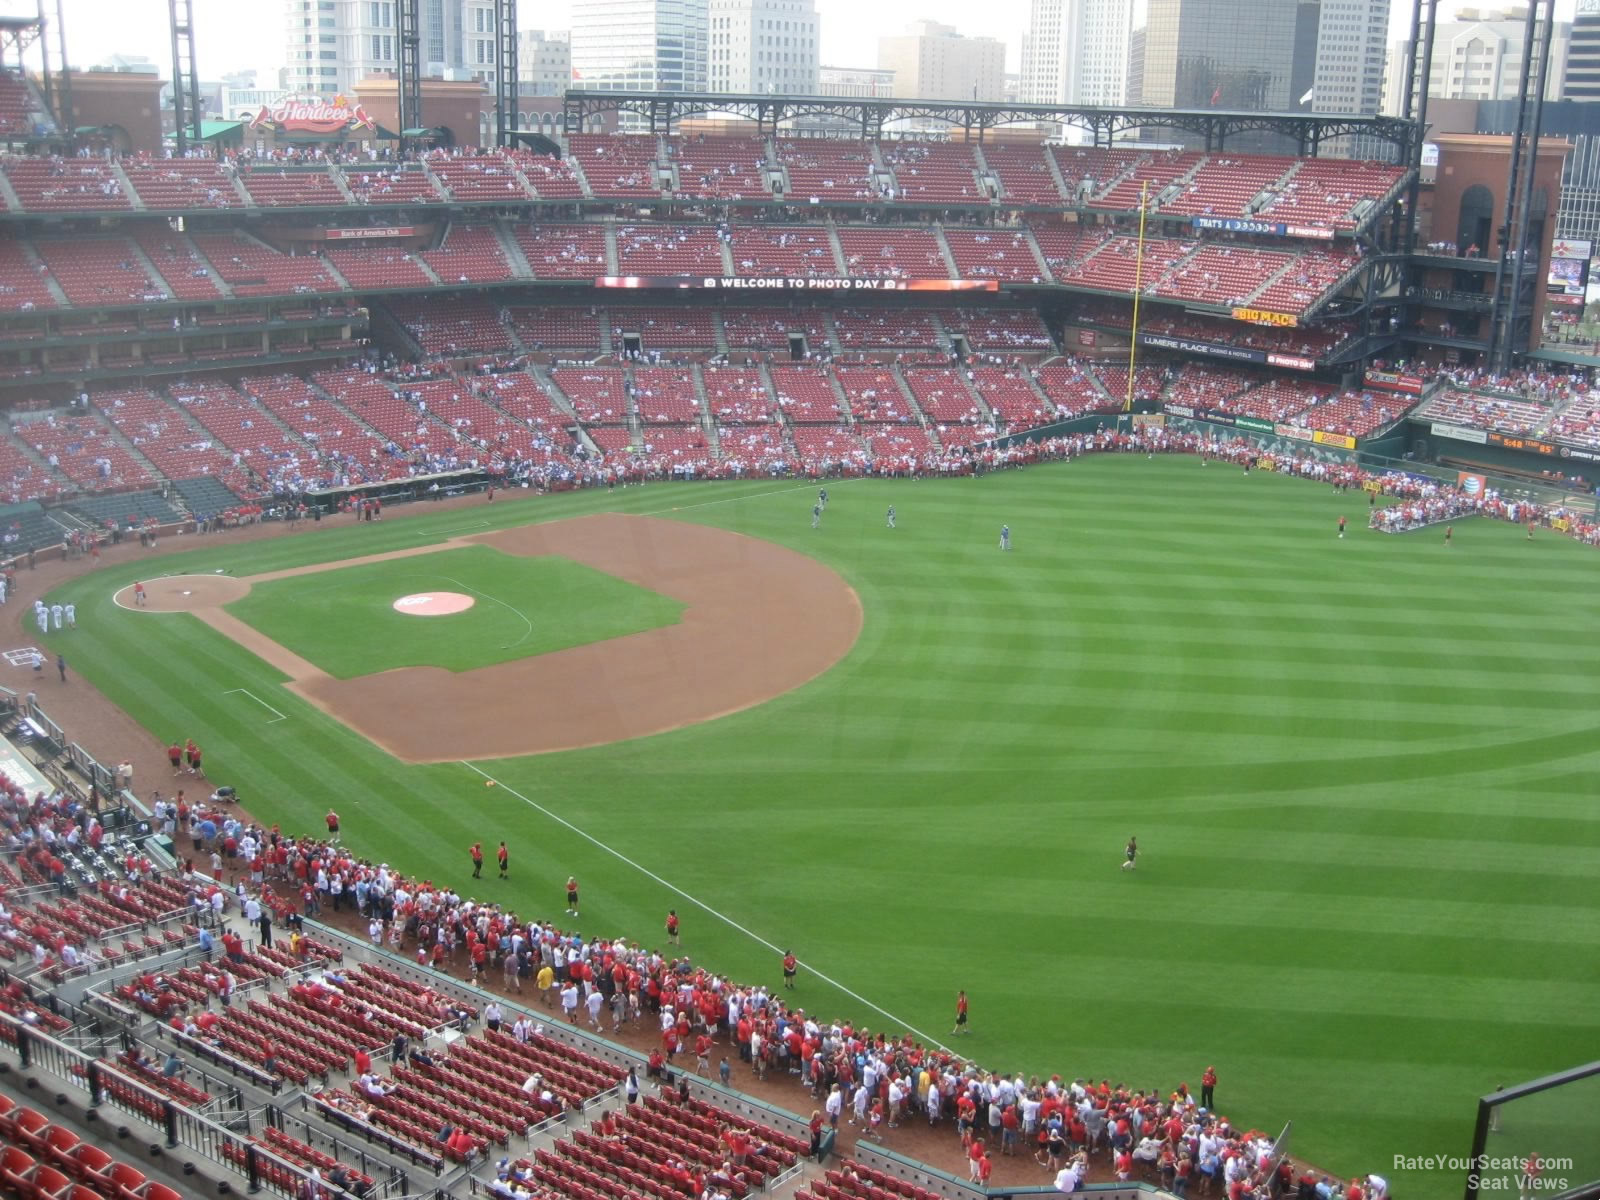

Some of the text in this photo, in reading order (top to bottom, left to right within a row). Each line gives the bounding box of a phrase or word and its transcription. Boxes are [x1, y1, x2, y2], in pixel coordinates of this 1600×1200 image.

[1225, 221, 1231, 230] A
[341, 230, 355, 238] Bank
[1295, 226, 1333, 239] PHOTO DAY
[721, 278, 880, 290] WELCOME TO PHOTO DAY
[1239, 309, 1289, 326] BIG MAC
[1179, 341, 1208, 353] PLACE
[1276, 356, 1314, 369] PHOTO DAY
